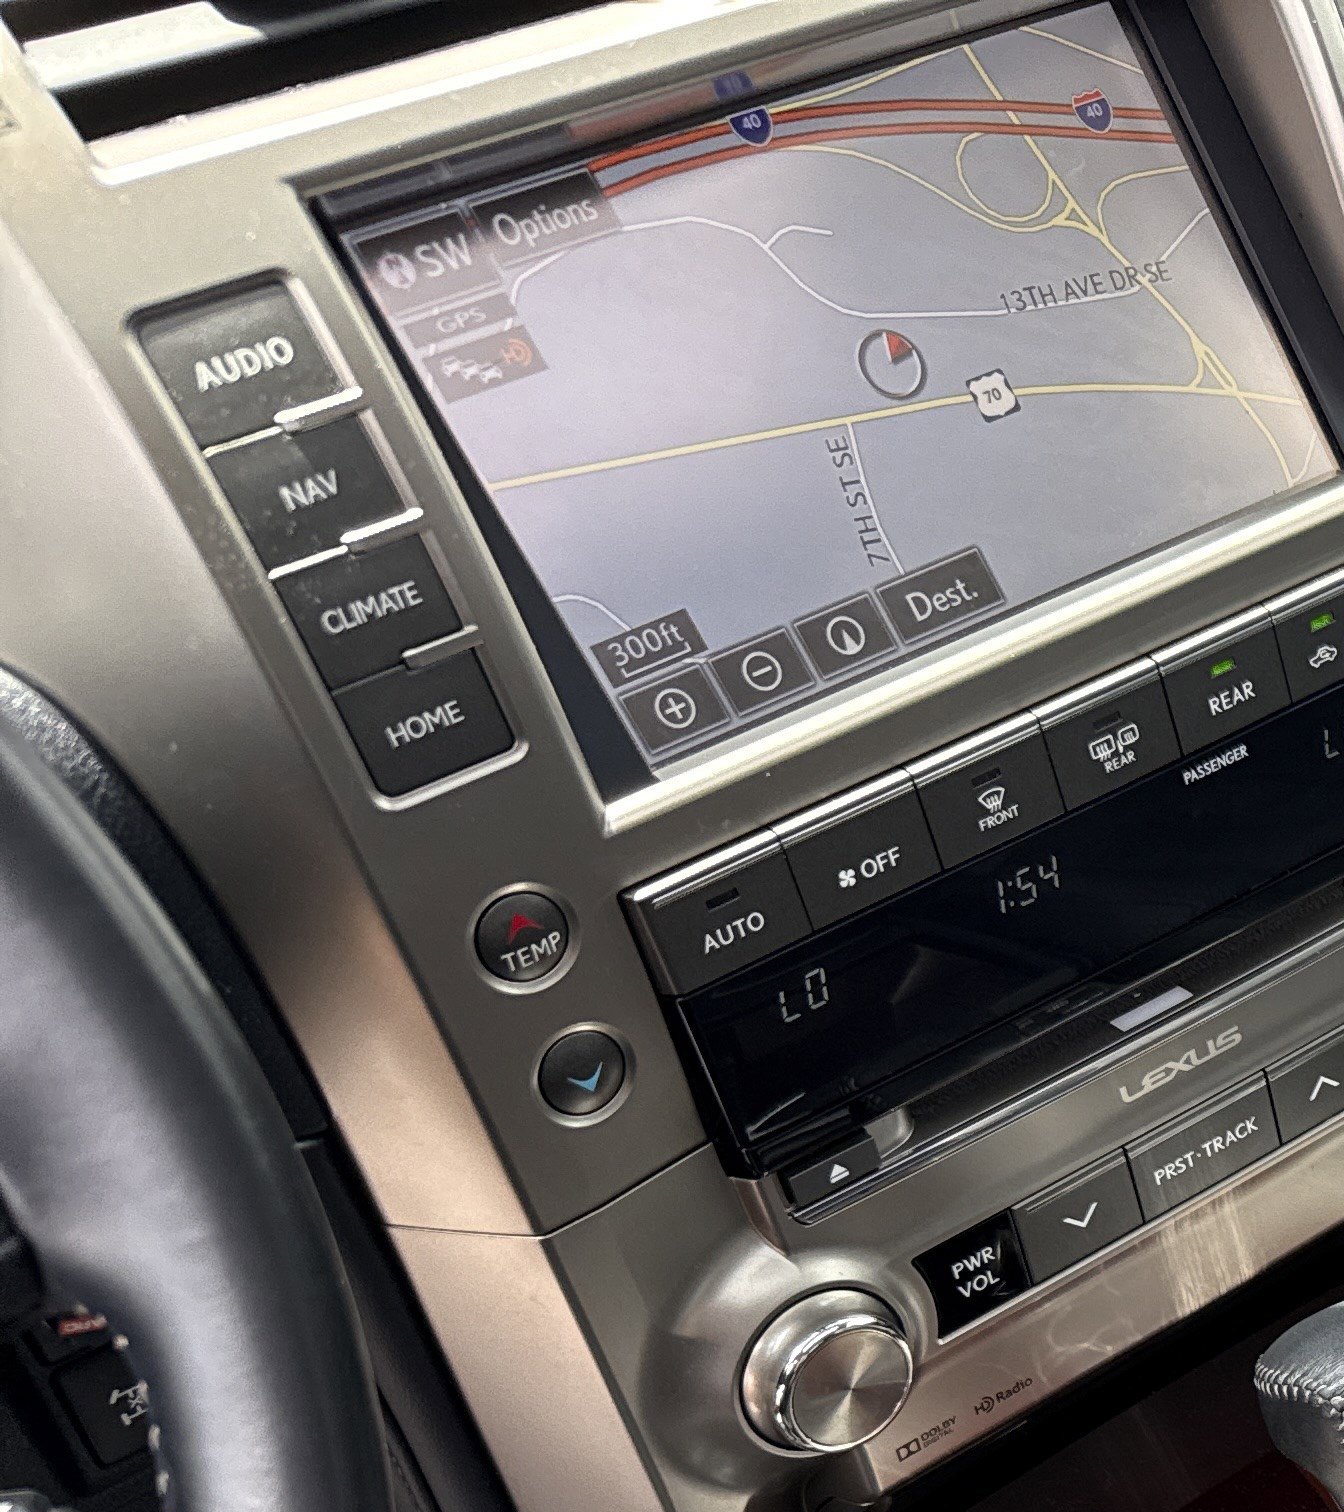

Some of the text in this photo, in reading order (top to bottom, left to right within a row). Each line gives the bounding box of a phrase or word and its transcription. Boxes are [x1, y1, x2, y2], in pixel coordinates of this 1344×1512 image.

[741, 113, 762, 133] 40
[1085, 101, 1104, 121] 40
[491, 200, 599, 247] Options
[415, 233, 473, 278] SW
[1000, 260, 1172, 314] 13TH AVE DR SE
[435, 307, 487, 333] GPS
[194, 335, 294, 393] AUDIO
[982, 387, 1002, 404] 70
[278, 469, 340, 512] NAV
[825, 435, 891, 567] 7TH ST SE
[320, 580, 424, 636] CLIMATE
[905, 579, 979, 622] Dest.
[607, 623, 684, 668] 300ft
[1208, 681, 1257, 716] REAR
[385, 700, 466, 749] HOME
[1104, 750, 1137, 774] REAR
[1183, 744, 1250, 785] PASSENGER
[978, 804, 1020, 832] FRONT
[860, 847, 902, 879] OFF
[997, 855, 1062, 914] 1:54
[500, 931, 561, 972] TEMP
[703, 911, 767, 954] AUTO
[1120, 1025, 1242, 1103] LEXUS
[951, 1246, 996, 1280] PWR
[956, 1270, 1000, 1298] VOL
[995, 1378, 1033, 1403] Radio
[920, 1415, 957, 1441] DOLBY
